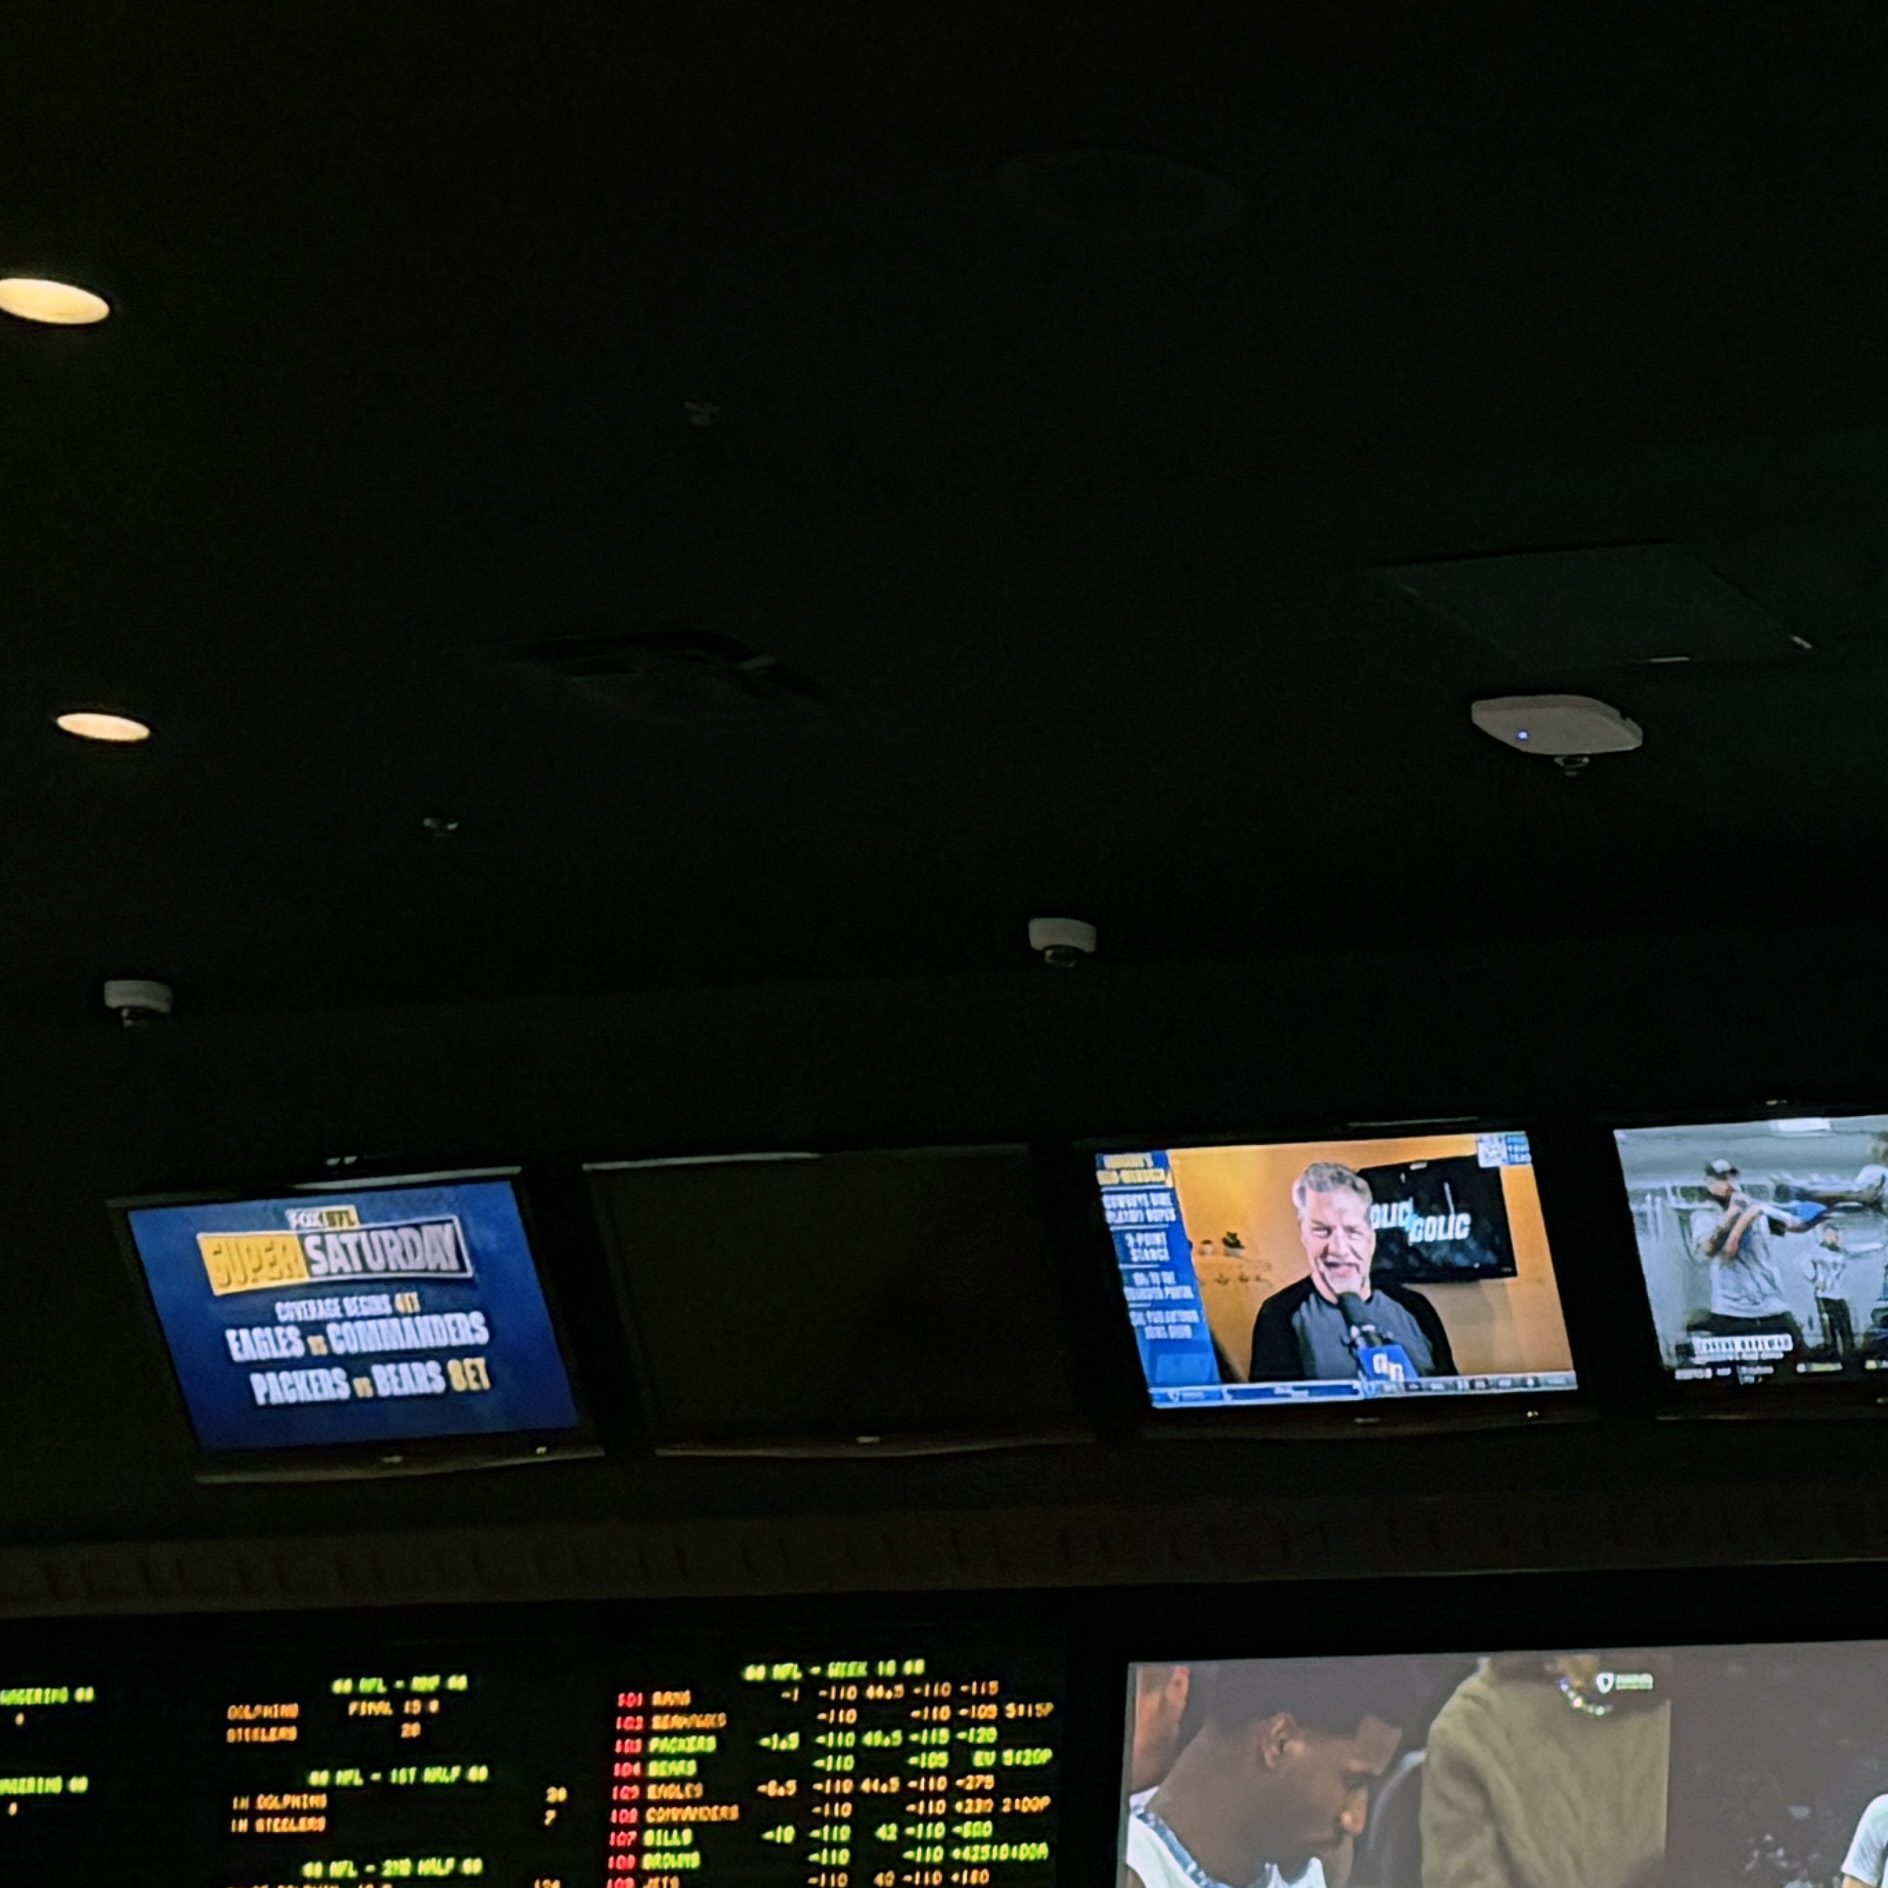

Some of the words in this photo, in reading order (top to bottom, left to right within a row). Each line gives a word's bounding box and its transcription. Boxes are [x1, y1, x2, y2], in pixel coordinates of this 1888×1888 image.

[1371, 1202, 1414, 1231] OLIC
[211, 1237, 303, 1288] SUPER
[305, 1224, 460, 1275] SATURDAY
[275, 1297, 341, 1321] COVERAGE
[225, 1326, 306, 1362] EAGLES
[326, 1312, 489, 1354] COMMANDERS
[250, 1366, 350, 1406] PACKERS
[372, 1361, 446, 1396] BEARS
[447, 1357, 491, 1392] 8ET
